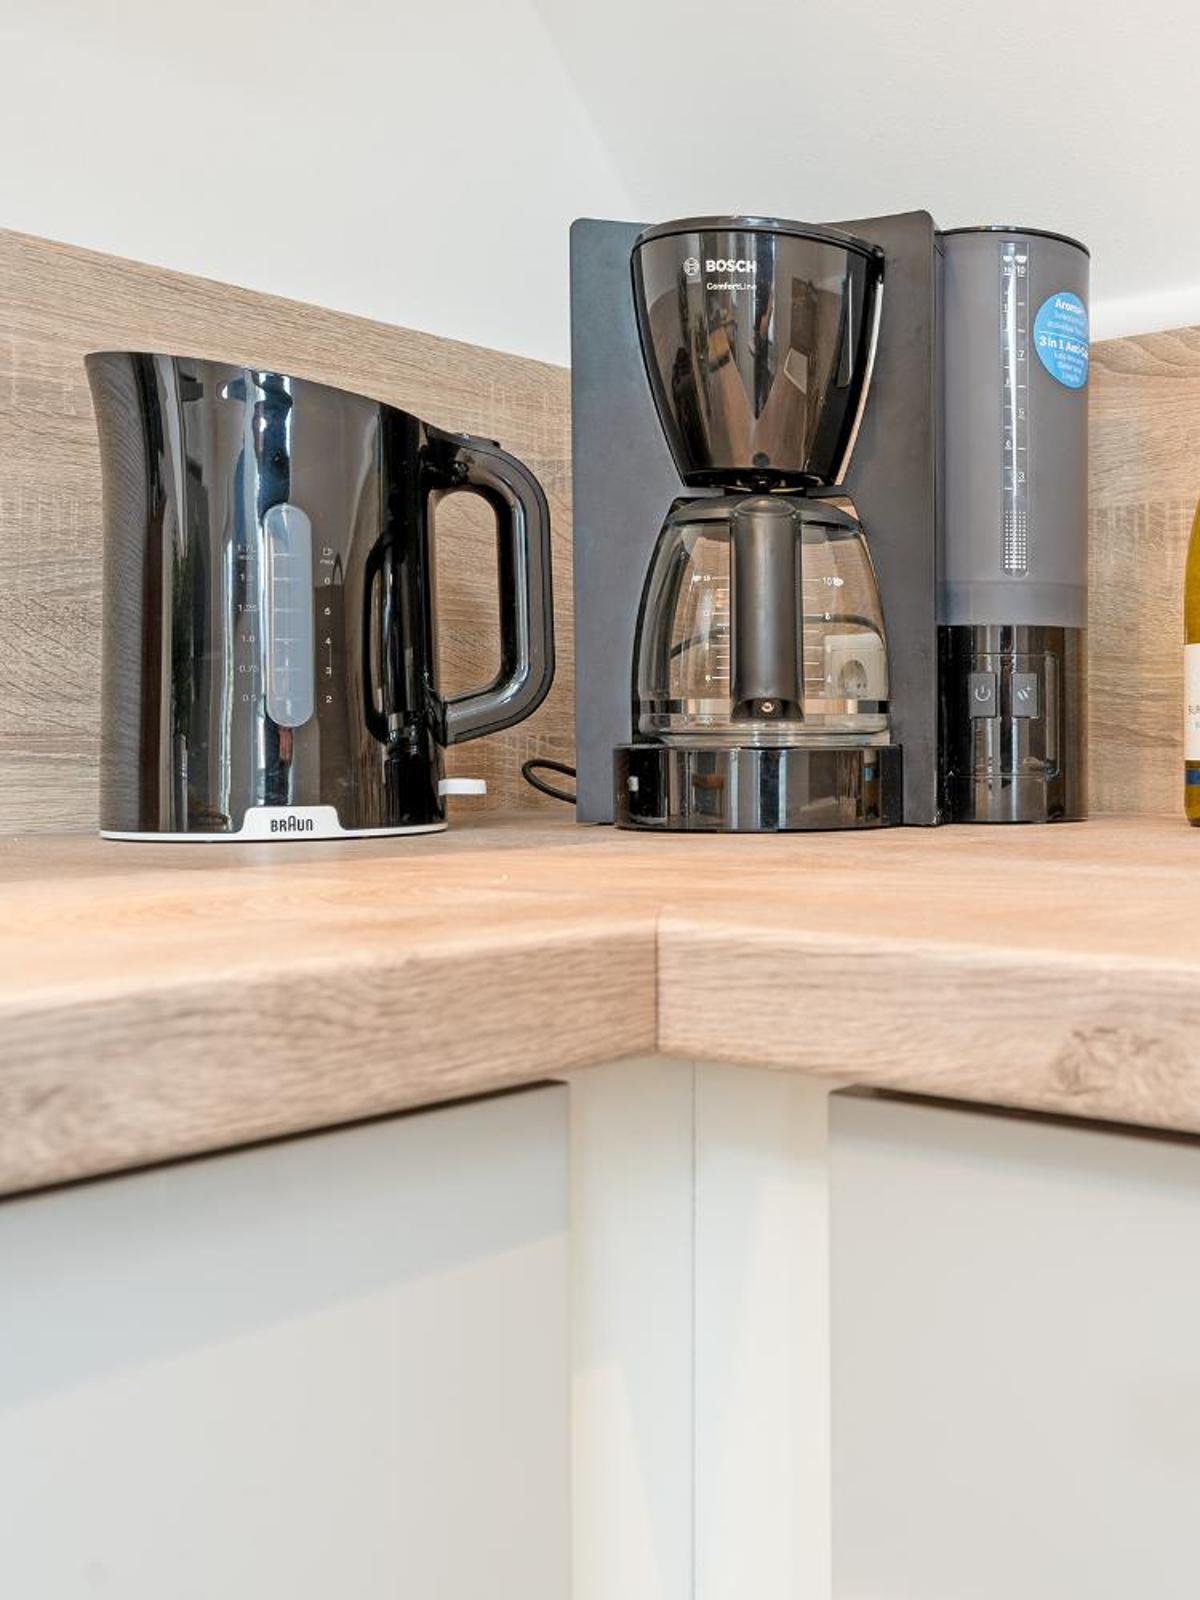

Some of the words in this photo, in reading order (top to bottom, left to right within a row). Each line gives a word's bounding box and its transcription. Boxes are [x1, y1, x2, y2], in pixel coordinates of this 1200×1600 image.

[705, 259, 757, 273] BOSCH
[1039, 335, 1047, 346] 3
[1047, 336, 1057, 348] in
[325, 695, 333, 704] 2
[270, 815, 314, 833] BRAUN
